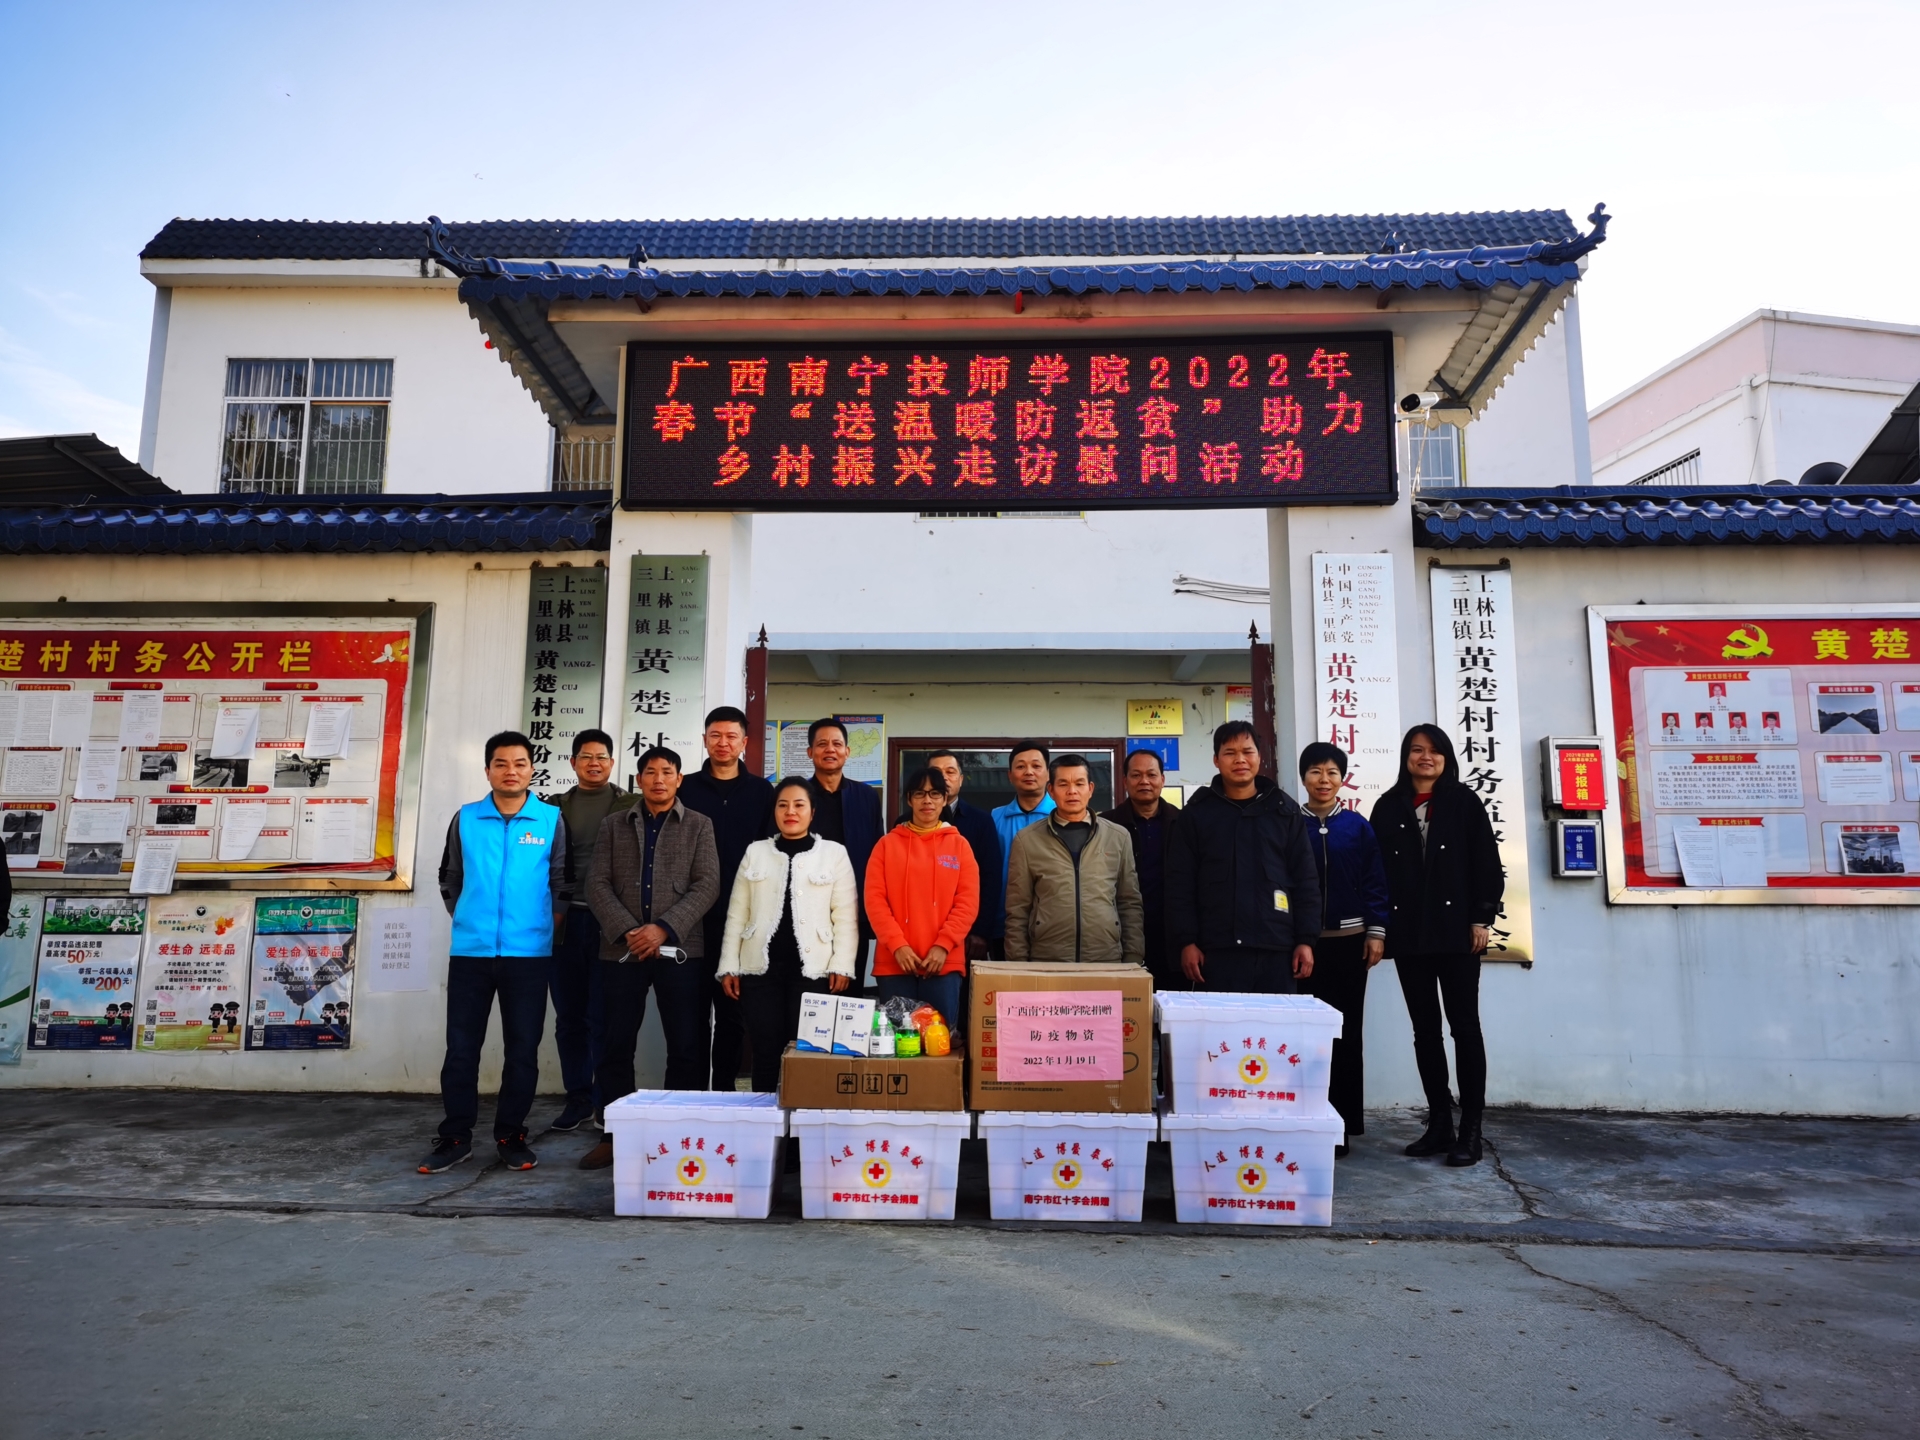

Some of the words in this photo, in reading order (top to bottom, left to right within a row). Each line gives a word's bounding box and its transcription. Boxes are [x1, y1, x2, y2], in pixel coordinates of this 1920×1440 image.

[666, 348, 1352, 397] 广西南宁技师学院2022年
[713, 441, 1305, 489] 乡村振兴走访慰问活动
[634, 567, 654, 635] 三里镇
[655, 565, 675, 635] 上林县
[1322, 563, 1336, 643] 上林县三里镇
[1338, 563, 1355, 643] 中国共产党
[1450, 574, 1473, 640] 三里镇
[1474, 574, 1497, 640] 上林县
[534, 577, 555, 643] 三里镇
[555, 575, 577, 643] 上林县
[0, 639, 312, 673] 楚村村务公开栏
[1361, 712, 1378, 720] CUJ
[1574, 763, 1588, 800] 举报箱
[384, 932, 412, 940] 佩戴口罩
[158, 943, 194, 956] 爱生命
[199, 943, 236, 956] 远毒品
[266, 946, 302, 959] 爱生命
[308, 945, 344, 958] 远毒品
[383, 942, 412, 950] 出入扫码
[382, 952, 411, 960] 测量体温
[381, 962, 410, 970] 做好登记
[1007, 1005, 1112, 1016] 广西南宁技师学院捐赠
[1030, 1029, 1095, 1042] 防疫物资
[1209, 1087, 1296, 1102] 南宁市红十字会捐赠
[647, 1190, 734, 1204] 南宁市红十字会捐赠
[832, 1192, 919, 1205] 南宁市红十字会捐赠
[1024, 1194, 1110, 1207] 南宁市红十字会捐赠
[1208, 1197, 1296, 1211] 南宁市红十字会捐赠
